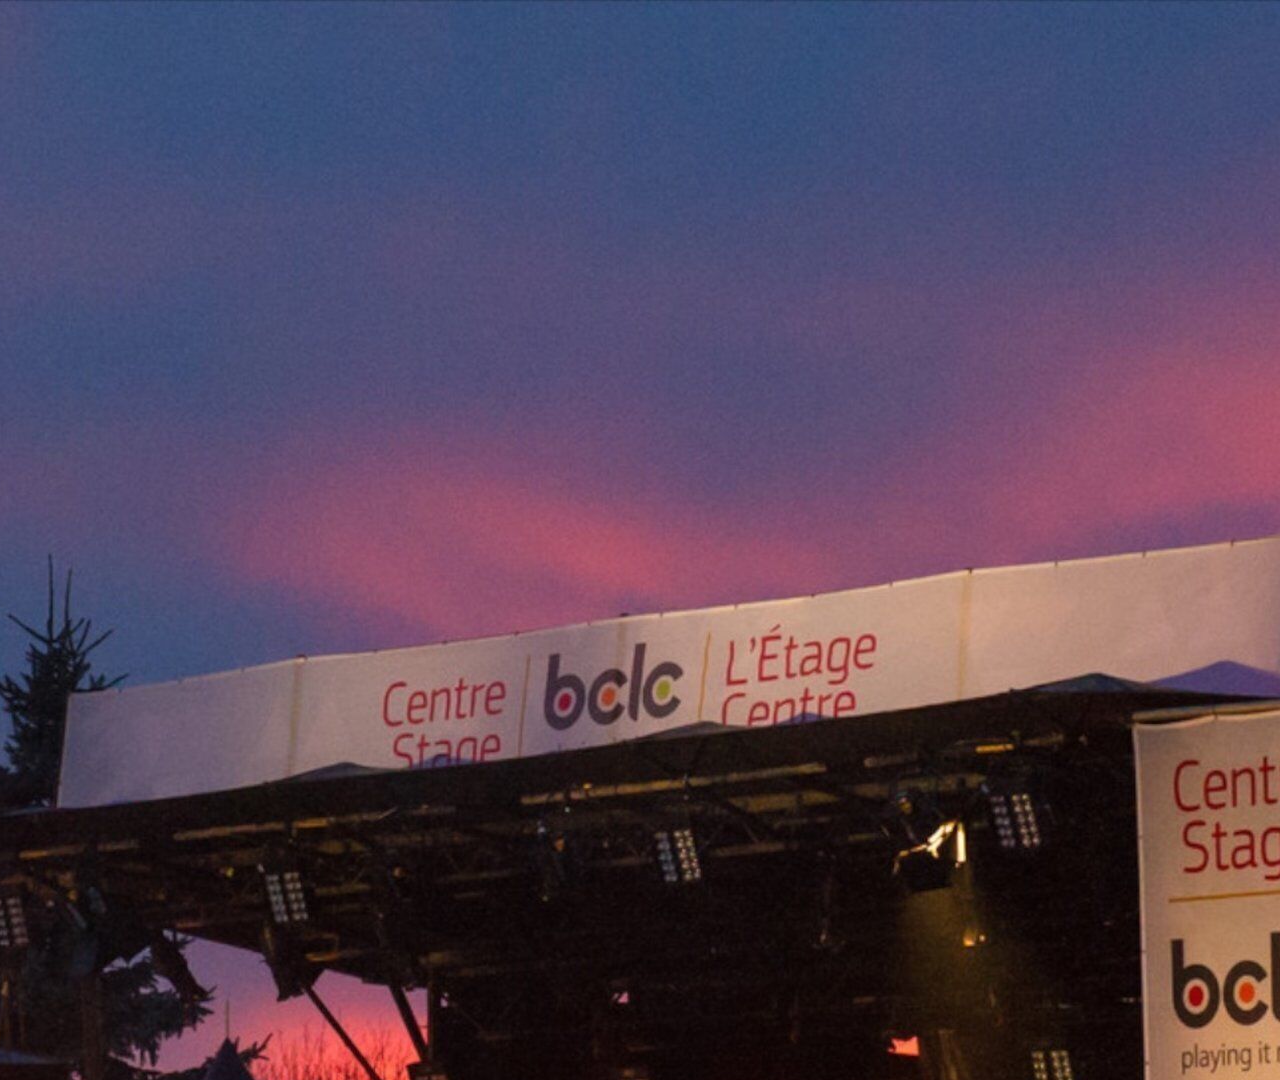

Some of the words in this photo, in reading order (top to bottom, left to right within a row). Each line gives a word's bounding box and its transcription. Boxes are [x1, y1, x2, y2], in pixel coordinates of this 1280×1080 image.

[725, 624, 877, 687] L'Étage
[382, 677, 506, 728] Centre
[544, 643, 684, 732] bclc
[1181, 1043, 1252, 1075] playing
[1258, 1041, 1270, 1065] it
